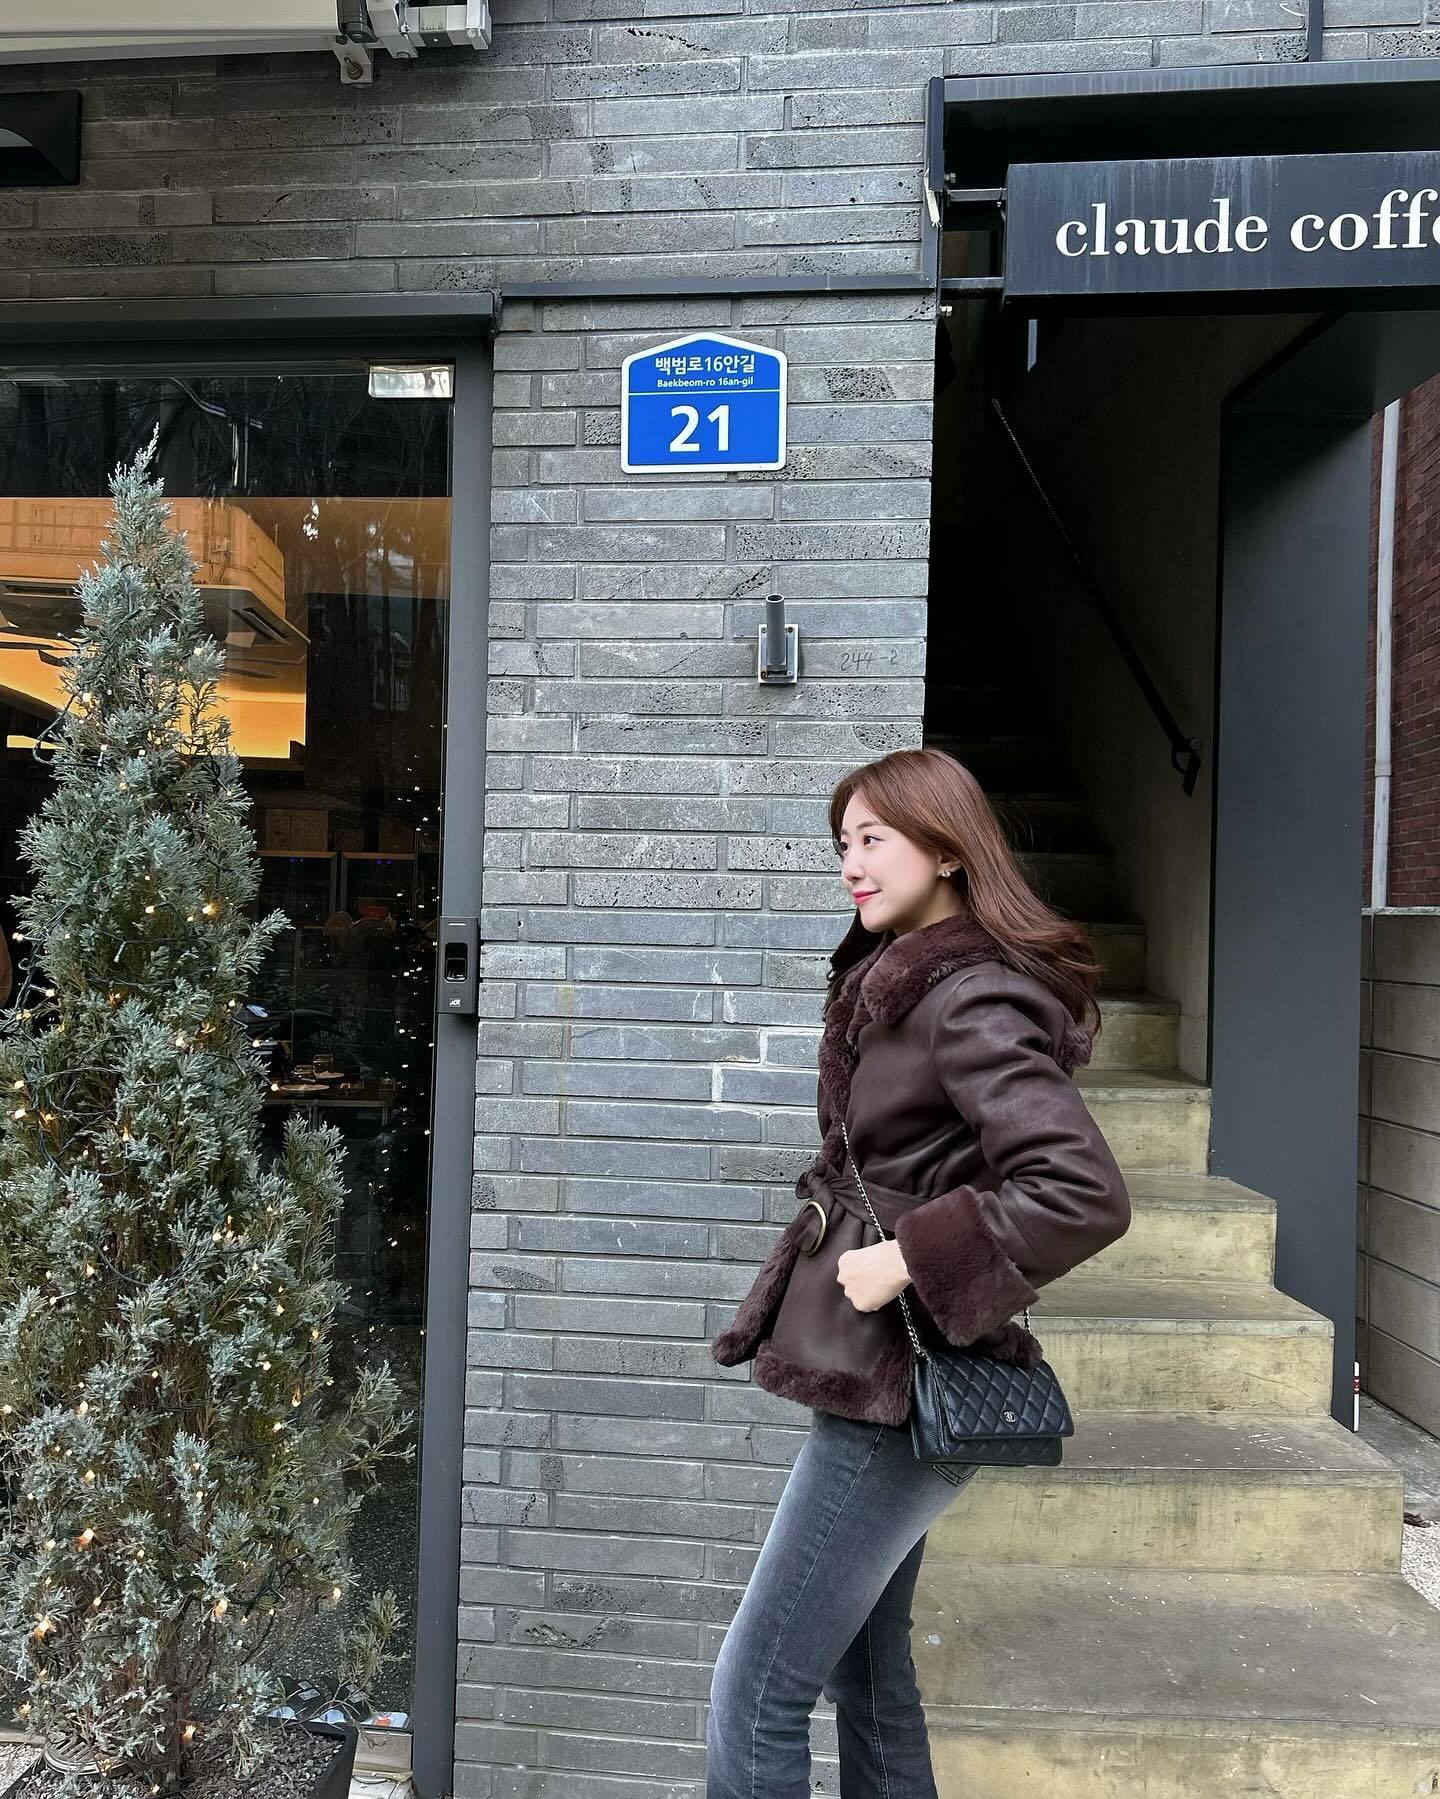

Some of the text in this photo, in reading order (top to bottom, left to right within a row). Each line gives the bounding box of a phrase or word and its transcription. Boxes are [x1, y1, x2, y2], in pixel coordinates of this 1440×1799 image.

[1056, 188, 1440, 256] claude coff
[655, 354, 755, 375] 백범로16안길
[657, 376, 754, 388] Baekbeom-ro 16an-gil
[669, 404, 730, 452] 21
